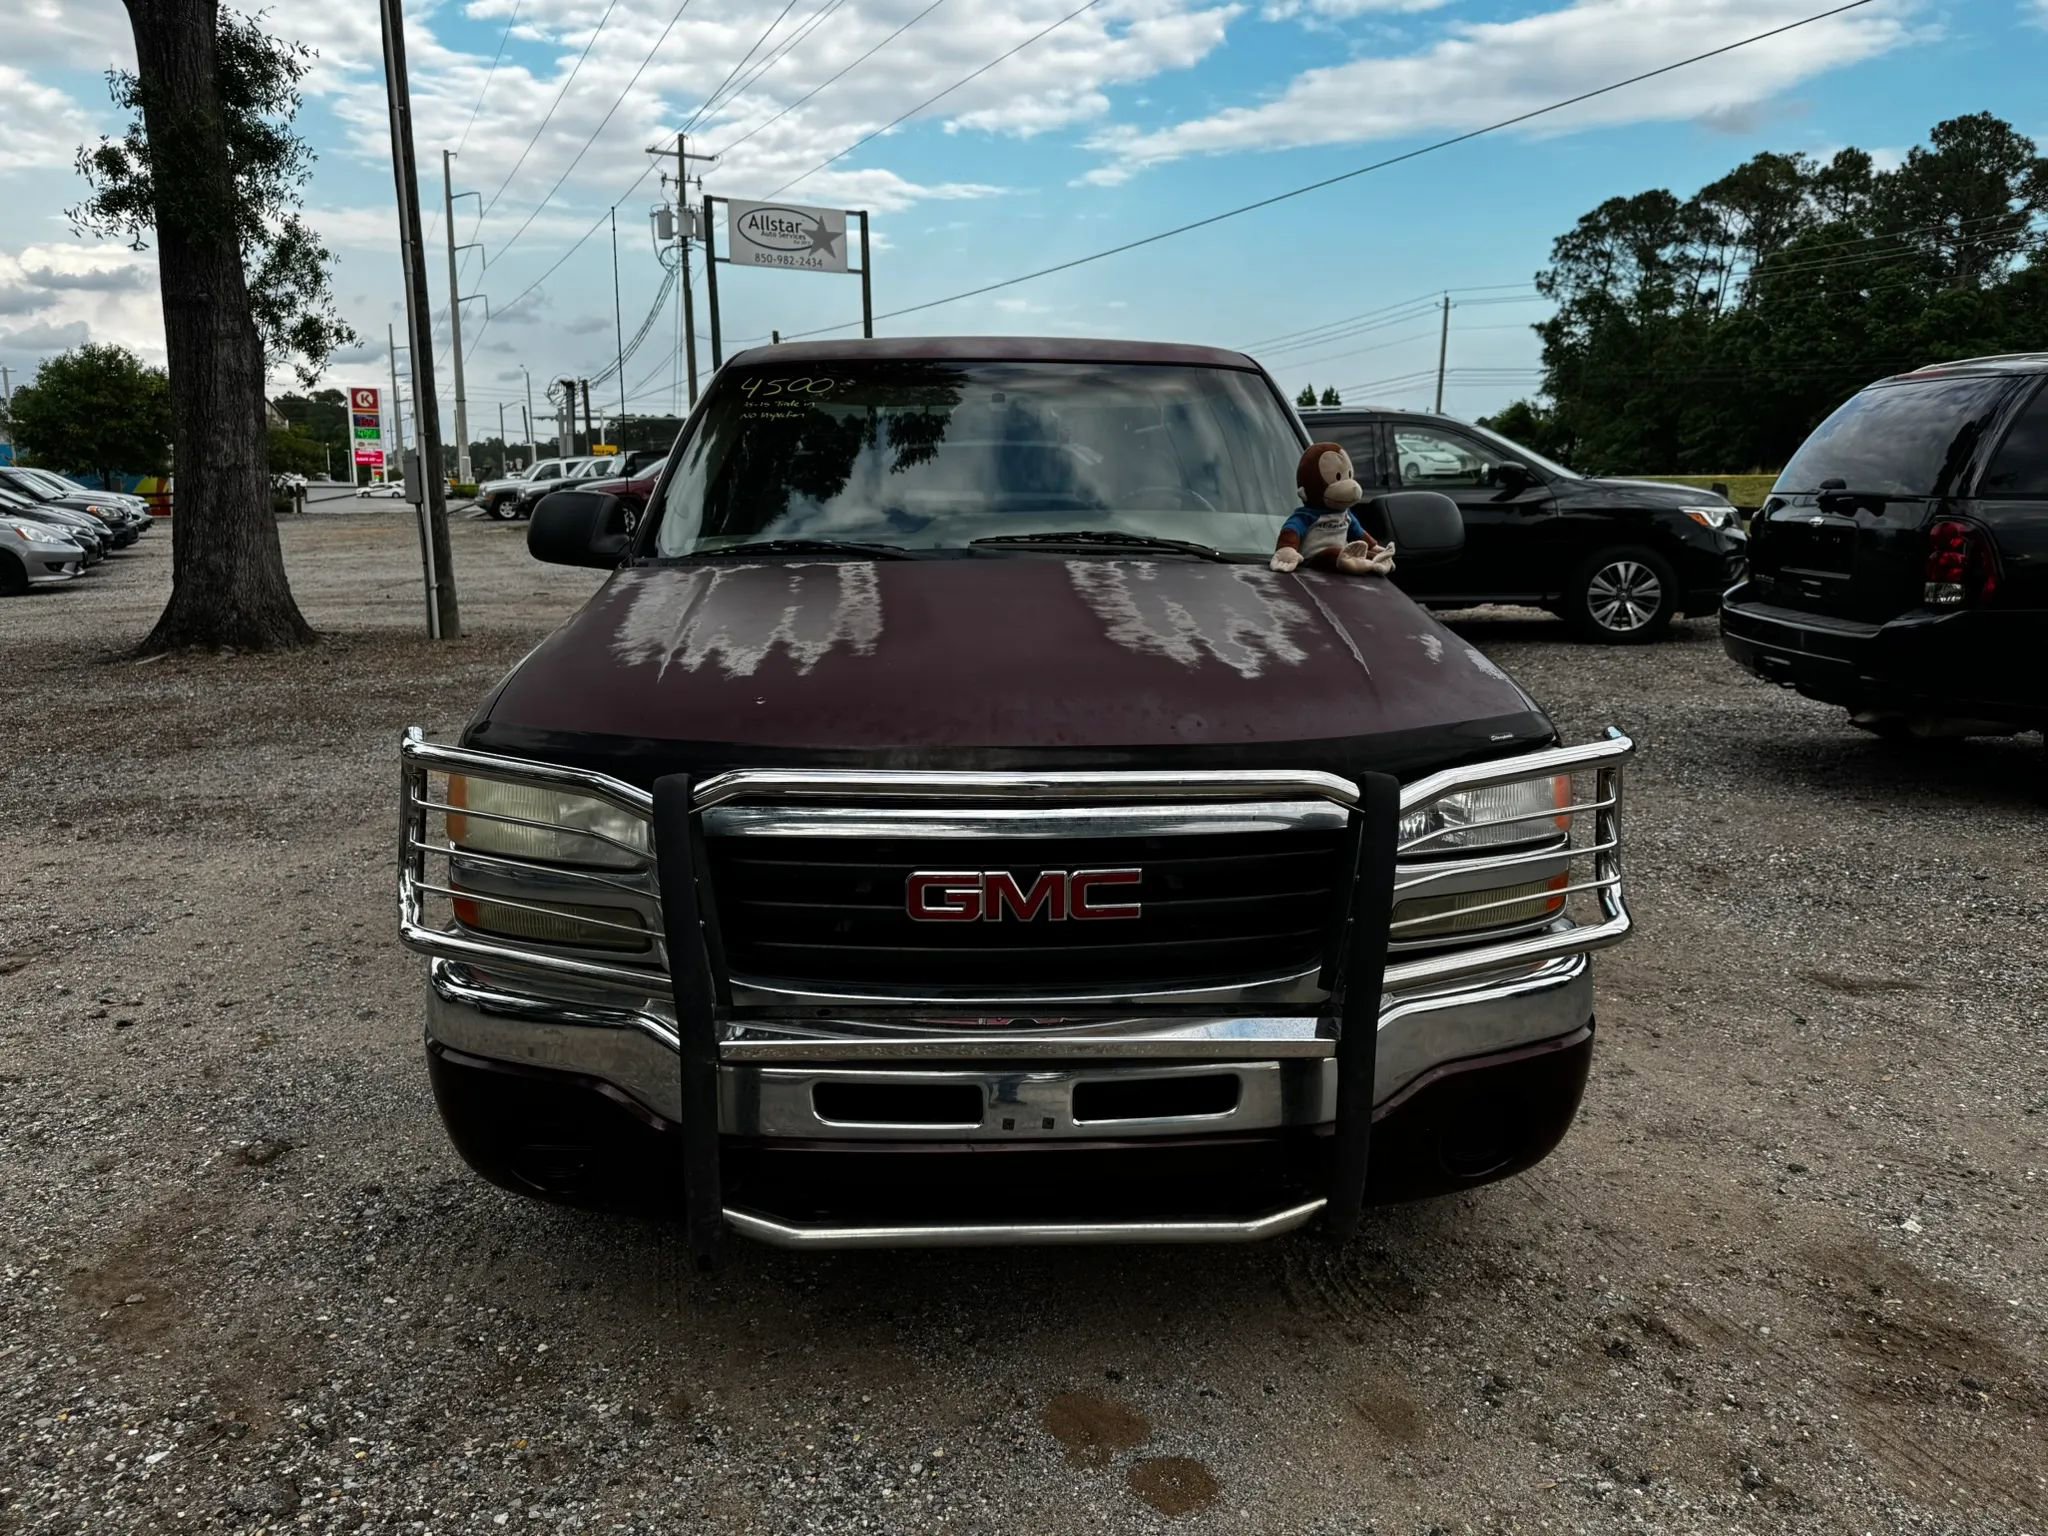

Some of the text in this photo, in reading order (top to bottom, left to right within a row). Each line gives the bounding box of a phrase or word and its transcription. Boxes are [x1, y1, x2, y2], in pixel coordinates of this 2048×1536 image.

[748, 214, 802, 234] Allstar
[754, 253, 823, 267] 850-982-2434
[741, 377, 834, 398] 4500
[906, 868, 1142, 922] GMC
